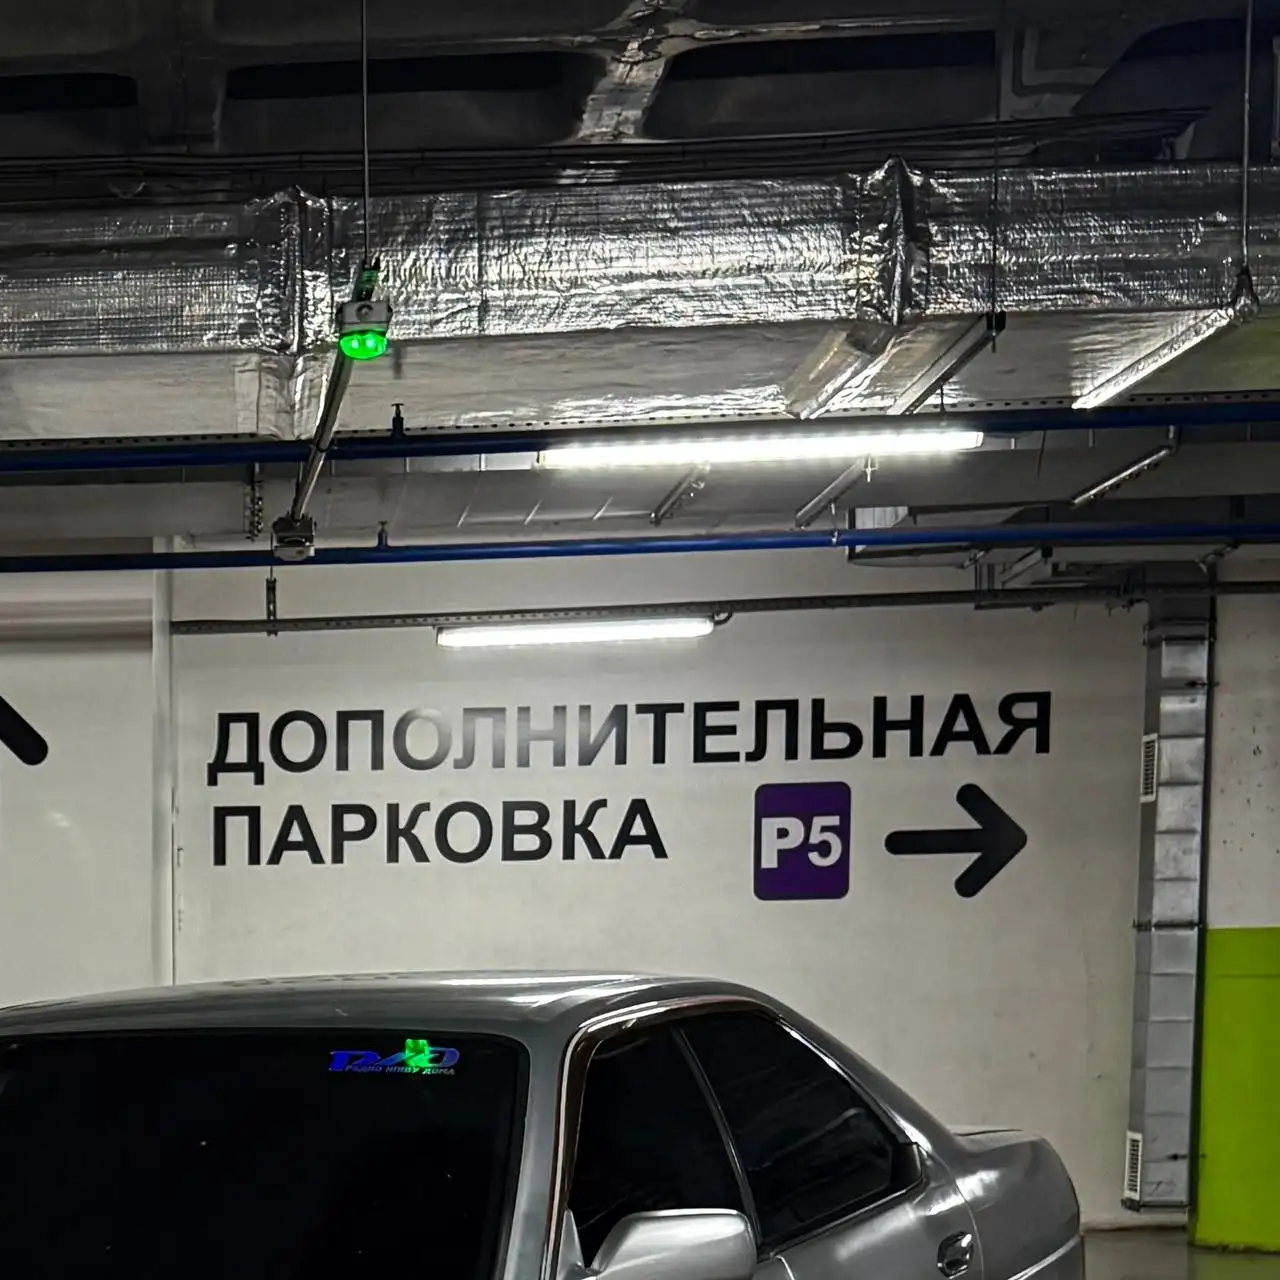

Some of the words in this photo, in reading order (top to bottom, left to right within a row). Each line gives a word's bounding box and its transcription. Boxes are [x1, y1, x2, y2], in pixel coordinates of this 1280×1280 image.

[206, 690, 1052, 787] ДОПОЛНИТЕЛЬНАЯ
[211, 798, 669, 867] ПАРКОВКА
[759, 814, 843, 870] P5
